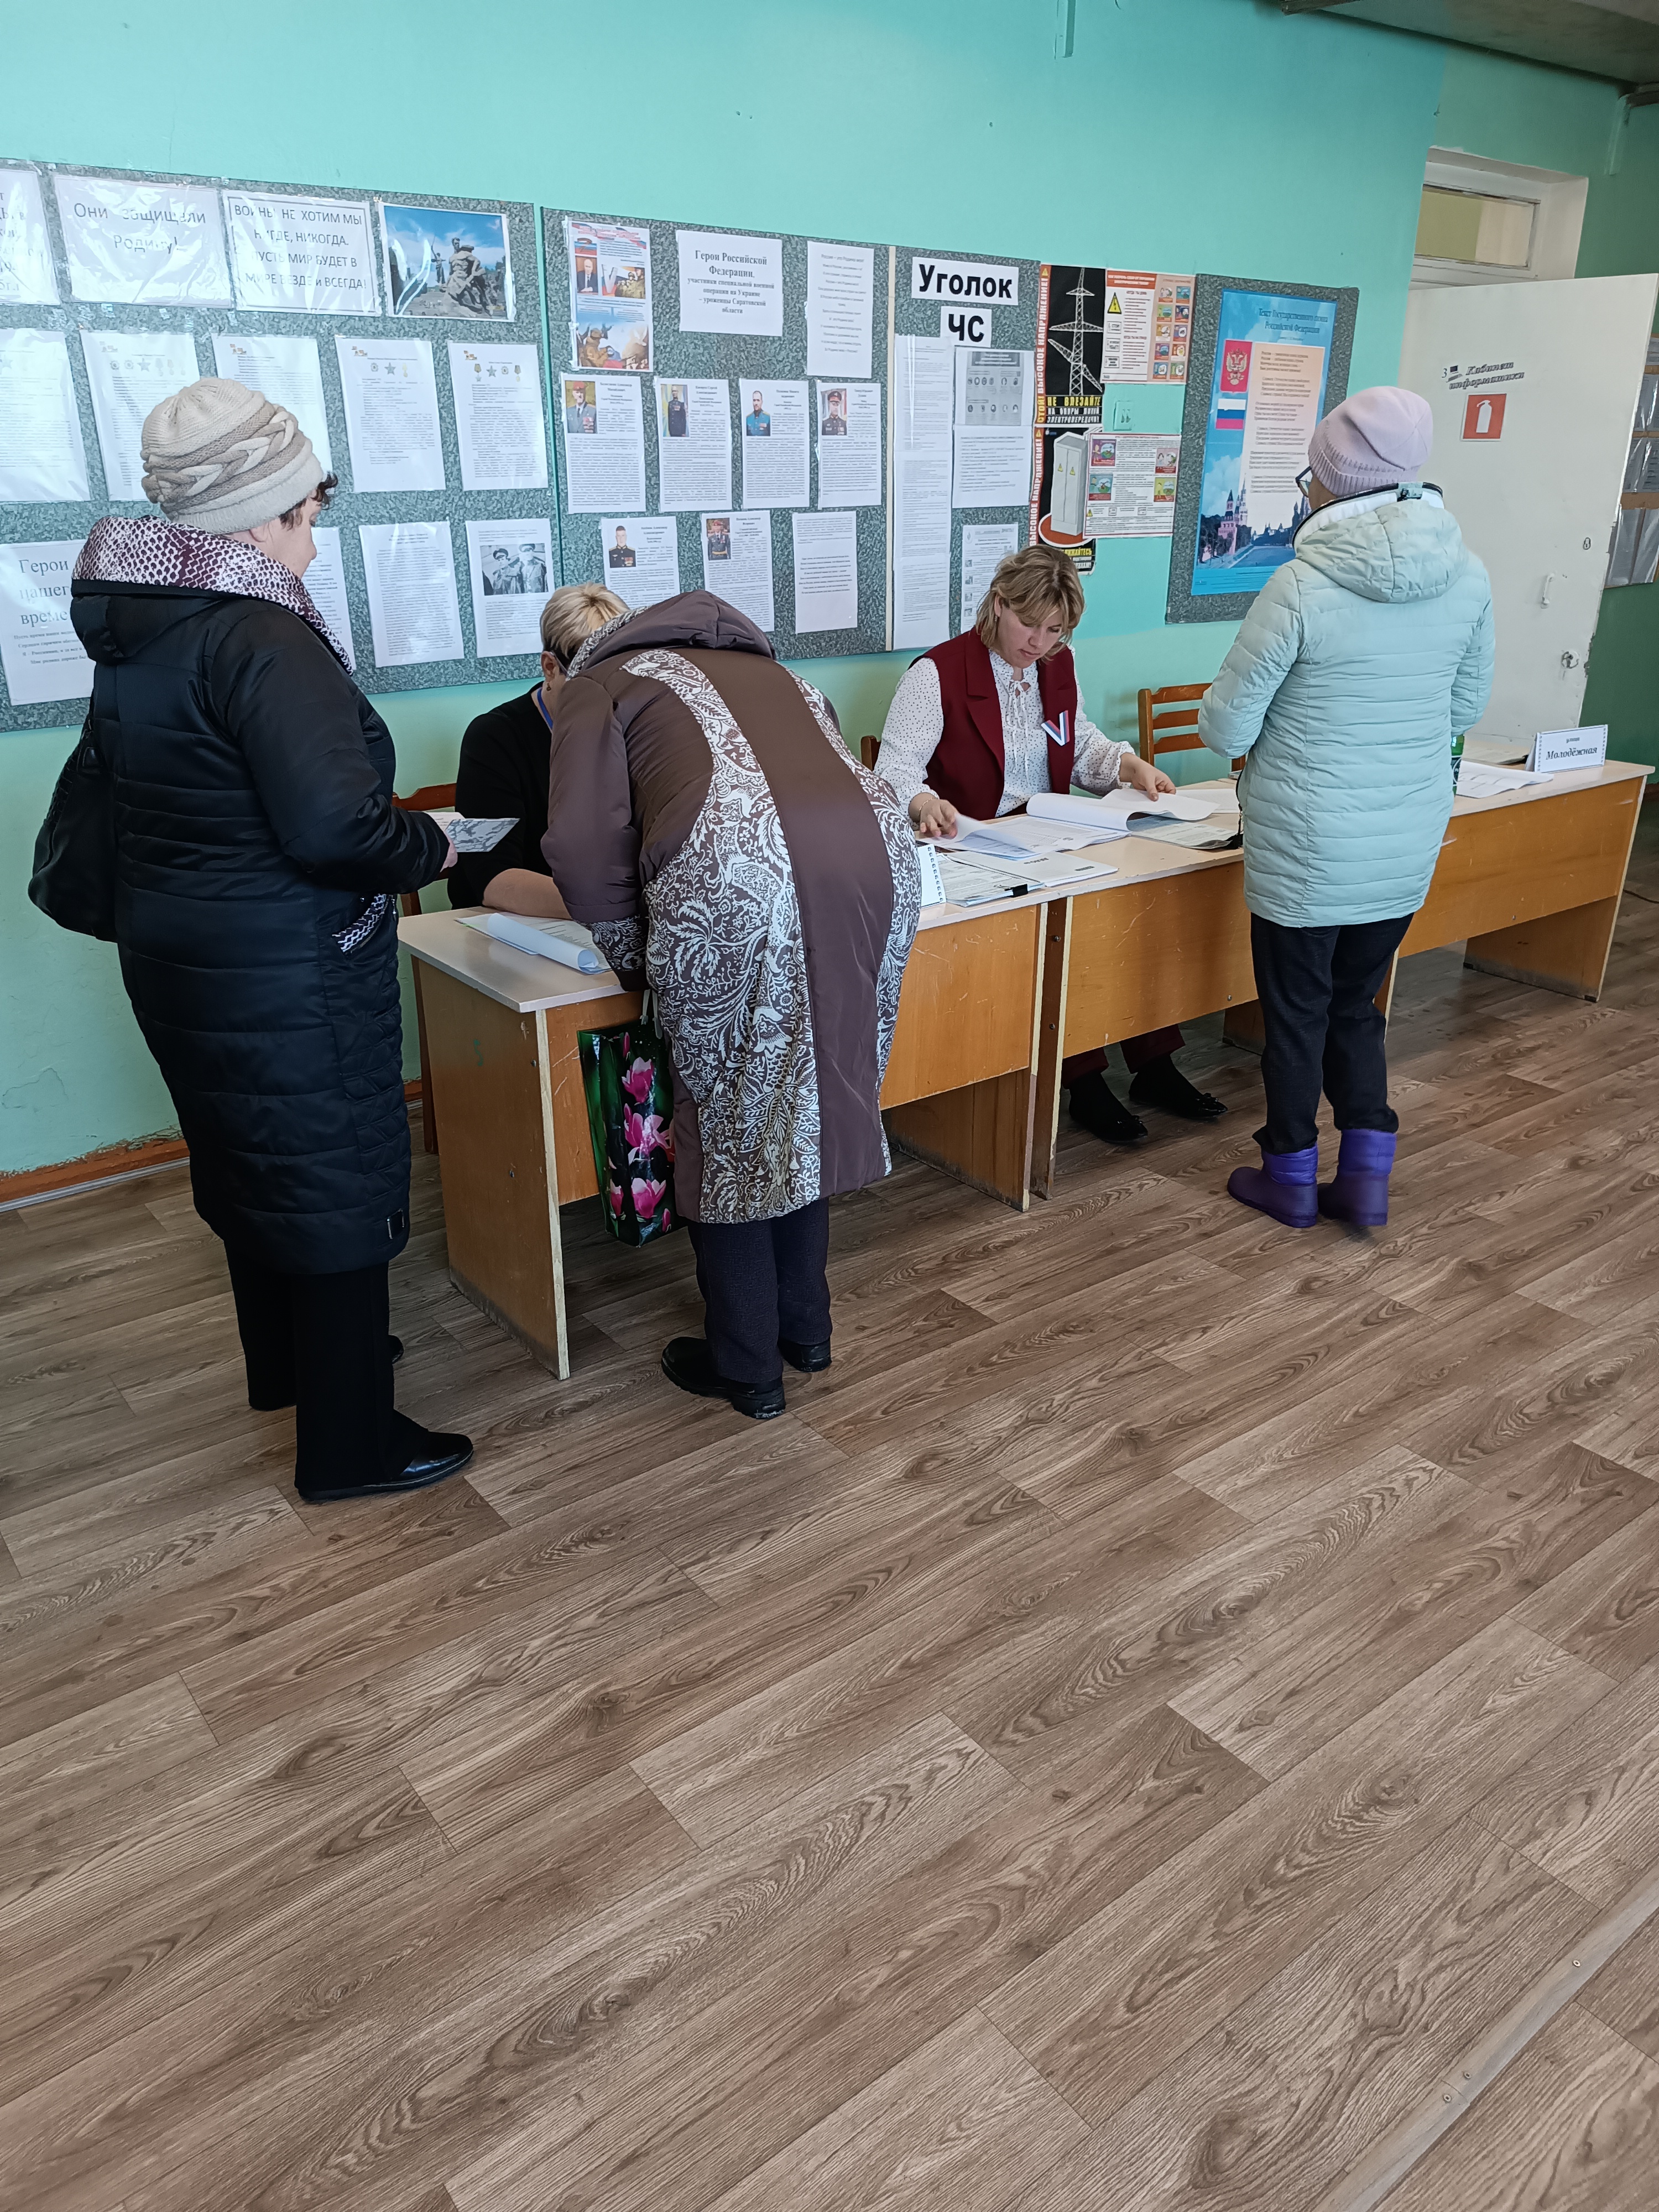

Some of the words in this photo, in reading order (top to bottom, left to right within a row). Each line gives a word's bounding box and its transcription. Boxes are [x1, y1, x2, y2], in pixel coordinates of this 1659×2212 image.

[74, 203, 108, 218] Они
[282, 209, 296, 220] НЕ
[301, 211, 340, 223] ХОТИМ
[343, 215, 362, 225] МЫ
[254, 229, 293, 243] НГДЕ,
[295, 233, 349, 247] НИКОГДА.
[252, 252, 285, 262] ПУСТЬ
[288, 254, 312, 264] МИР
[316, 255, 347, 268] БУДЕТ
[351, 258, 357, 267] В
[695, 250, 719, 262] Герои
[722, 253, 767, 265] Российской
[709, 265, 755, 278] Федерации,
[325, 278, 367, 290] ВСЕГДА!
[919, 264, 1012, 299] Уголок
[738, 289, 760, 298] Украине
[732, 298, 766, 306] Саратовской
[1039, 278, 1048, 346] НАПРЯЖЕНИЕ!
[948, 314, 984, 342] ЧС
[1037, 347, 1045, 394] ВЫСОКОЕ
[1465, 362, 1514, 375] Кабинет
[1449, 372, 1525, 390] информатики
[1047, 397, 1057, 406] НЕ
[1064, 395, 1100, 406] ВЛЕЗАЙТЕ
[1037, 396, 1045, 423] СТОЙ!
[1032, 439, 1042, 501] НАПРЯЖЕНИЕ!
[1029, 503, 1038, 546] ВЫСОКОЕ
[19, 560, 69, 576] Герои
[19, 586, 70, 599] нашег
[1546, 747, 1598, 760] Молодёжная
